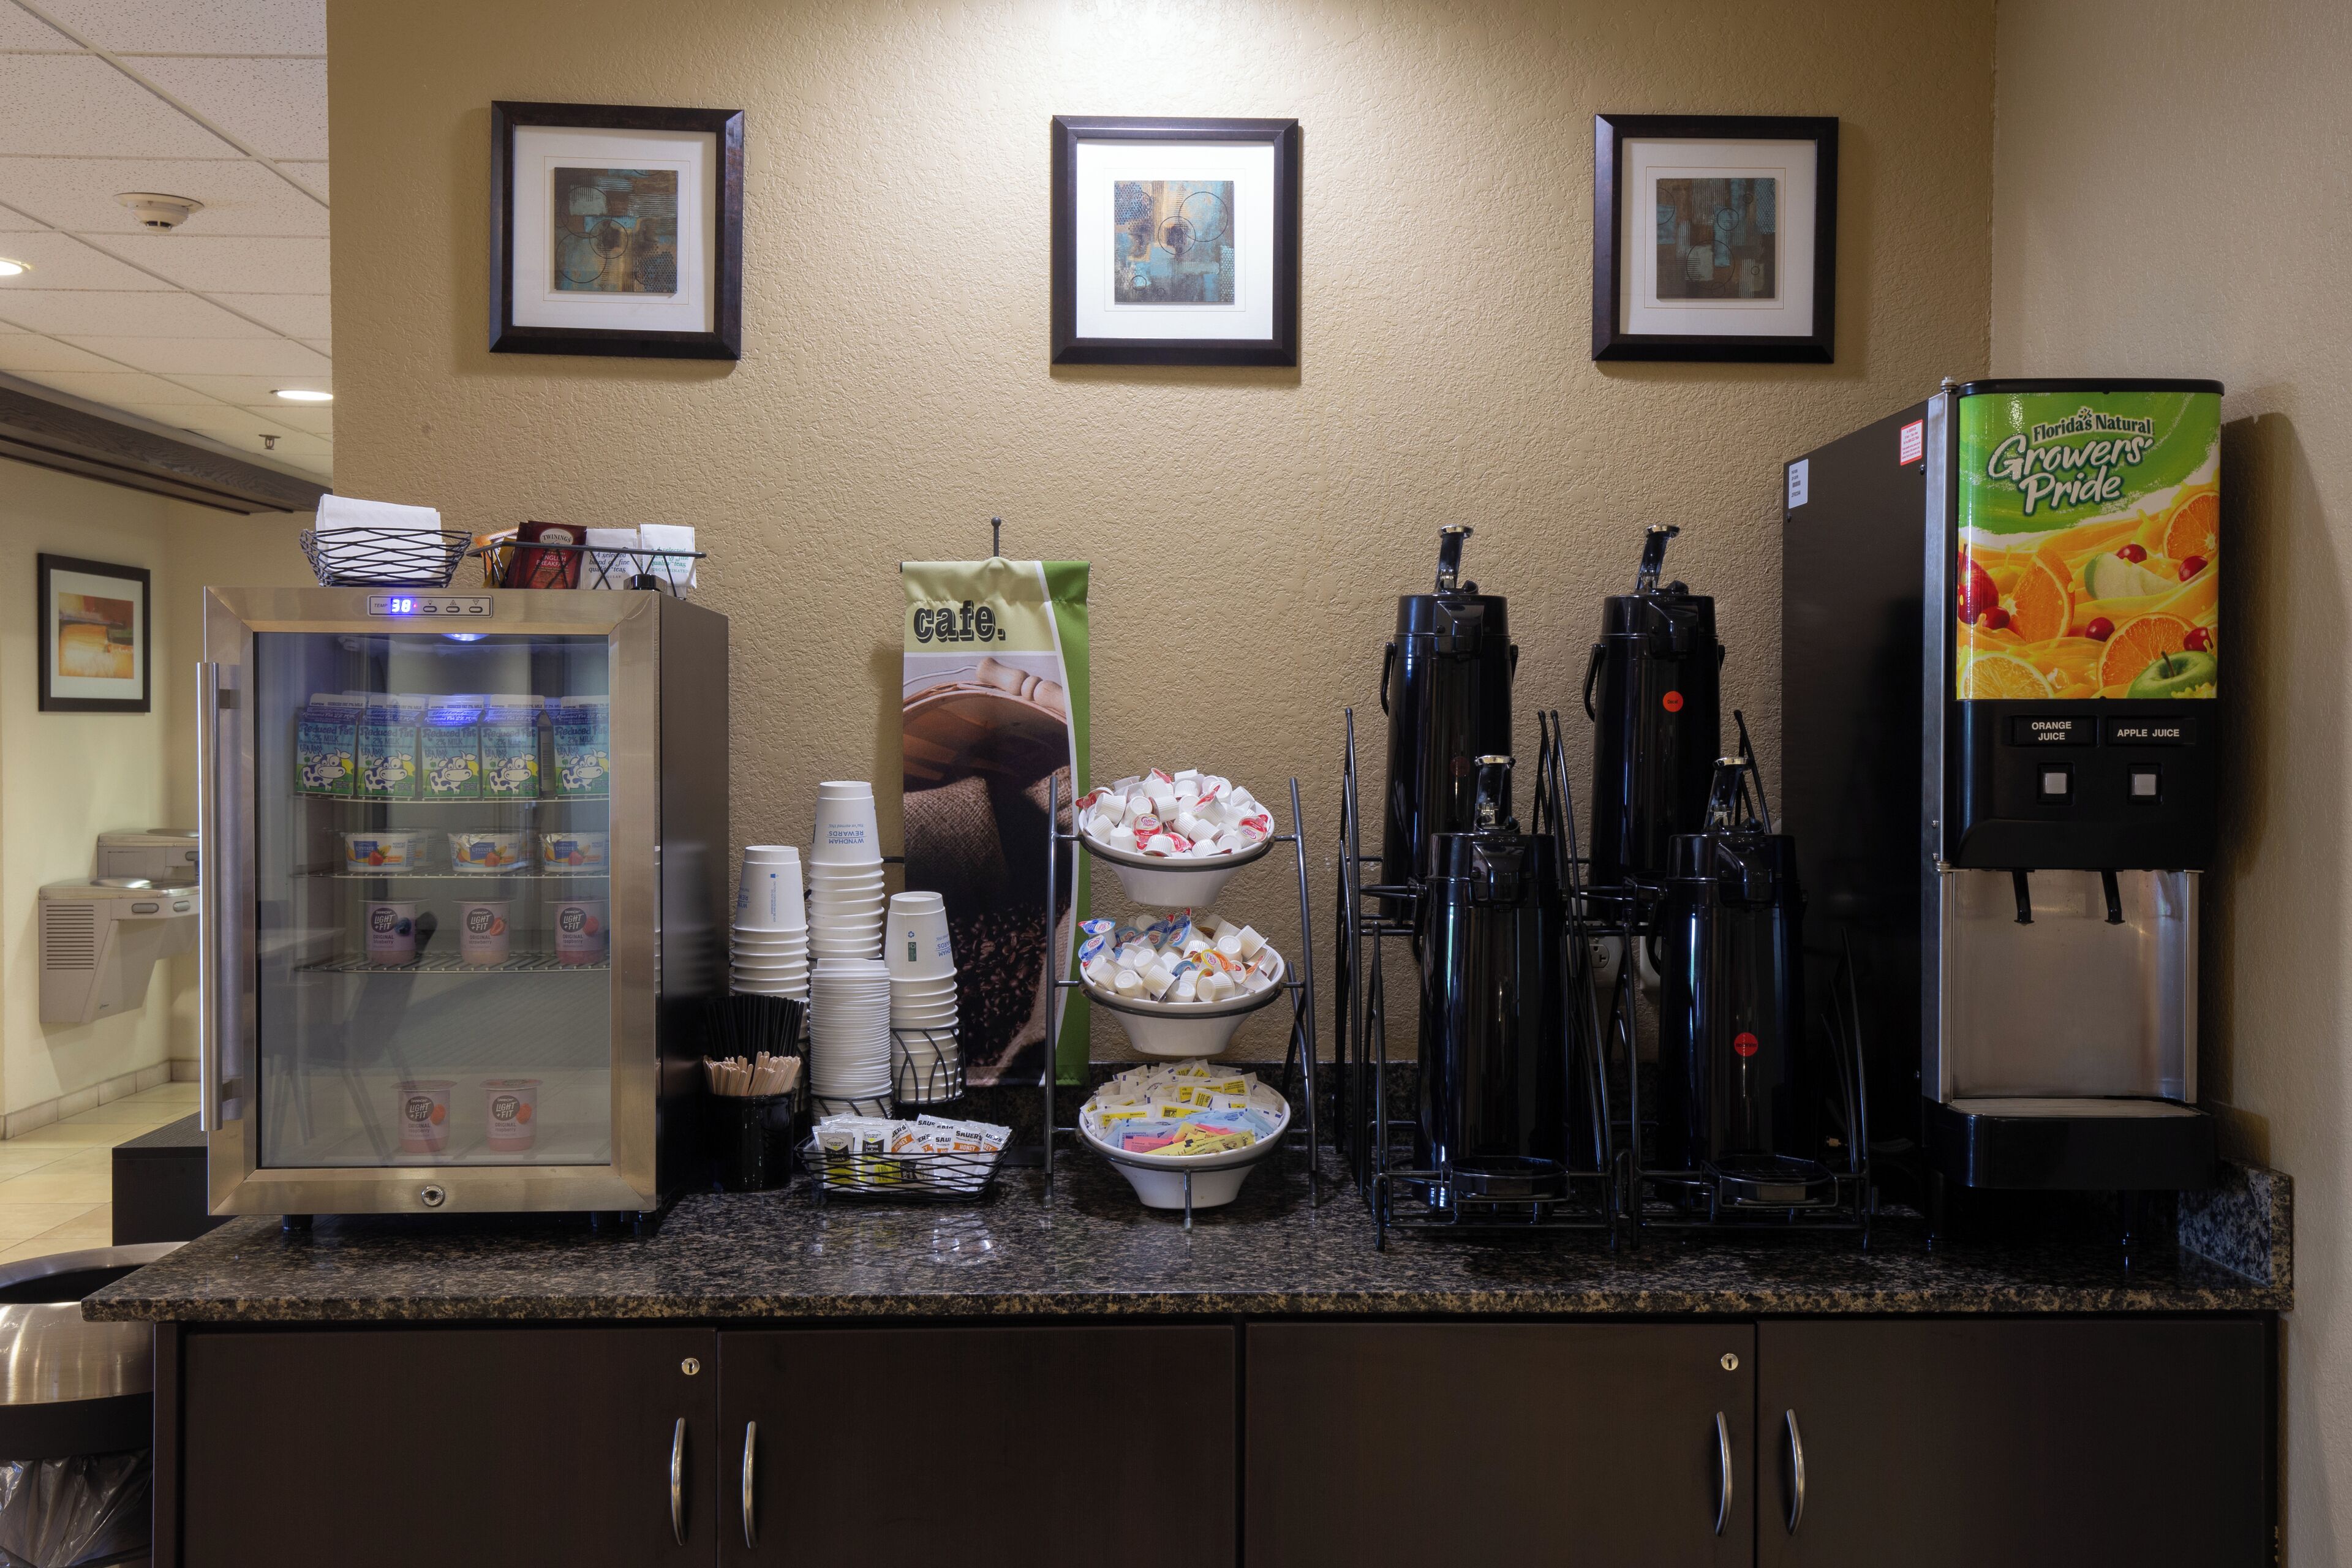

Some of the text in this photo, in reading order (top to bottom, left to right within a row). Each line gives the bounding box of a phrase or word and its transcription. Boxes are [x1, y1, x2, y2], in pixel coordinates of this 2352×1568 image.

[2095, 415, 2152, 434] Natural
[1988, 434, 2154, 480] Growers'
[2019, 465, 2123, 515] Pride
[543, 534, 571, 543] TWININGS
[914, 600, 1006, 643] cafe.
[299, 724, 353, 738] Reduced Fat
[2032, 722, 2072, 730] ORANGE
[360, 727, 398, 740] Reduced
[423, 727, 476, 741] Reduced Fat
[483, 727, 536, 742] Reduced Fat
[555, 726, 590, 740] Reduced
[2117, 729, 2147, 737] APPLE
[374, 914, 396, 924] LIGHT
[471, 914, 492, 924] LIGHT
[564, 913, 584, 923] LIGHT
[409, 1102, 431, 1113] LIGHT
[496, 1101, 518, 1112] LIGHT
[956, 1131, 983, 1141] SAUER'S
[895, 1137, 908, 1151] HONEY
